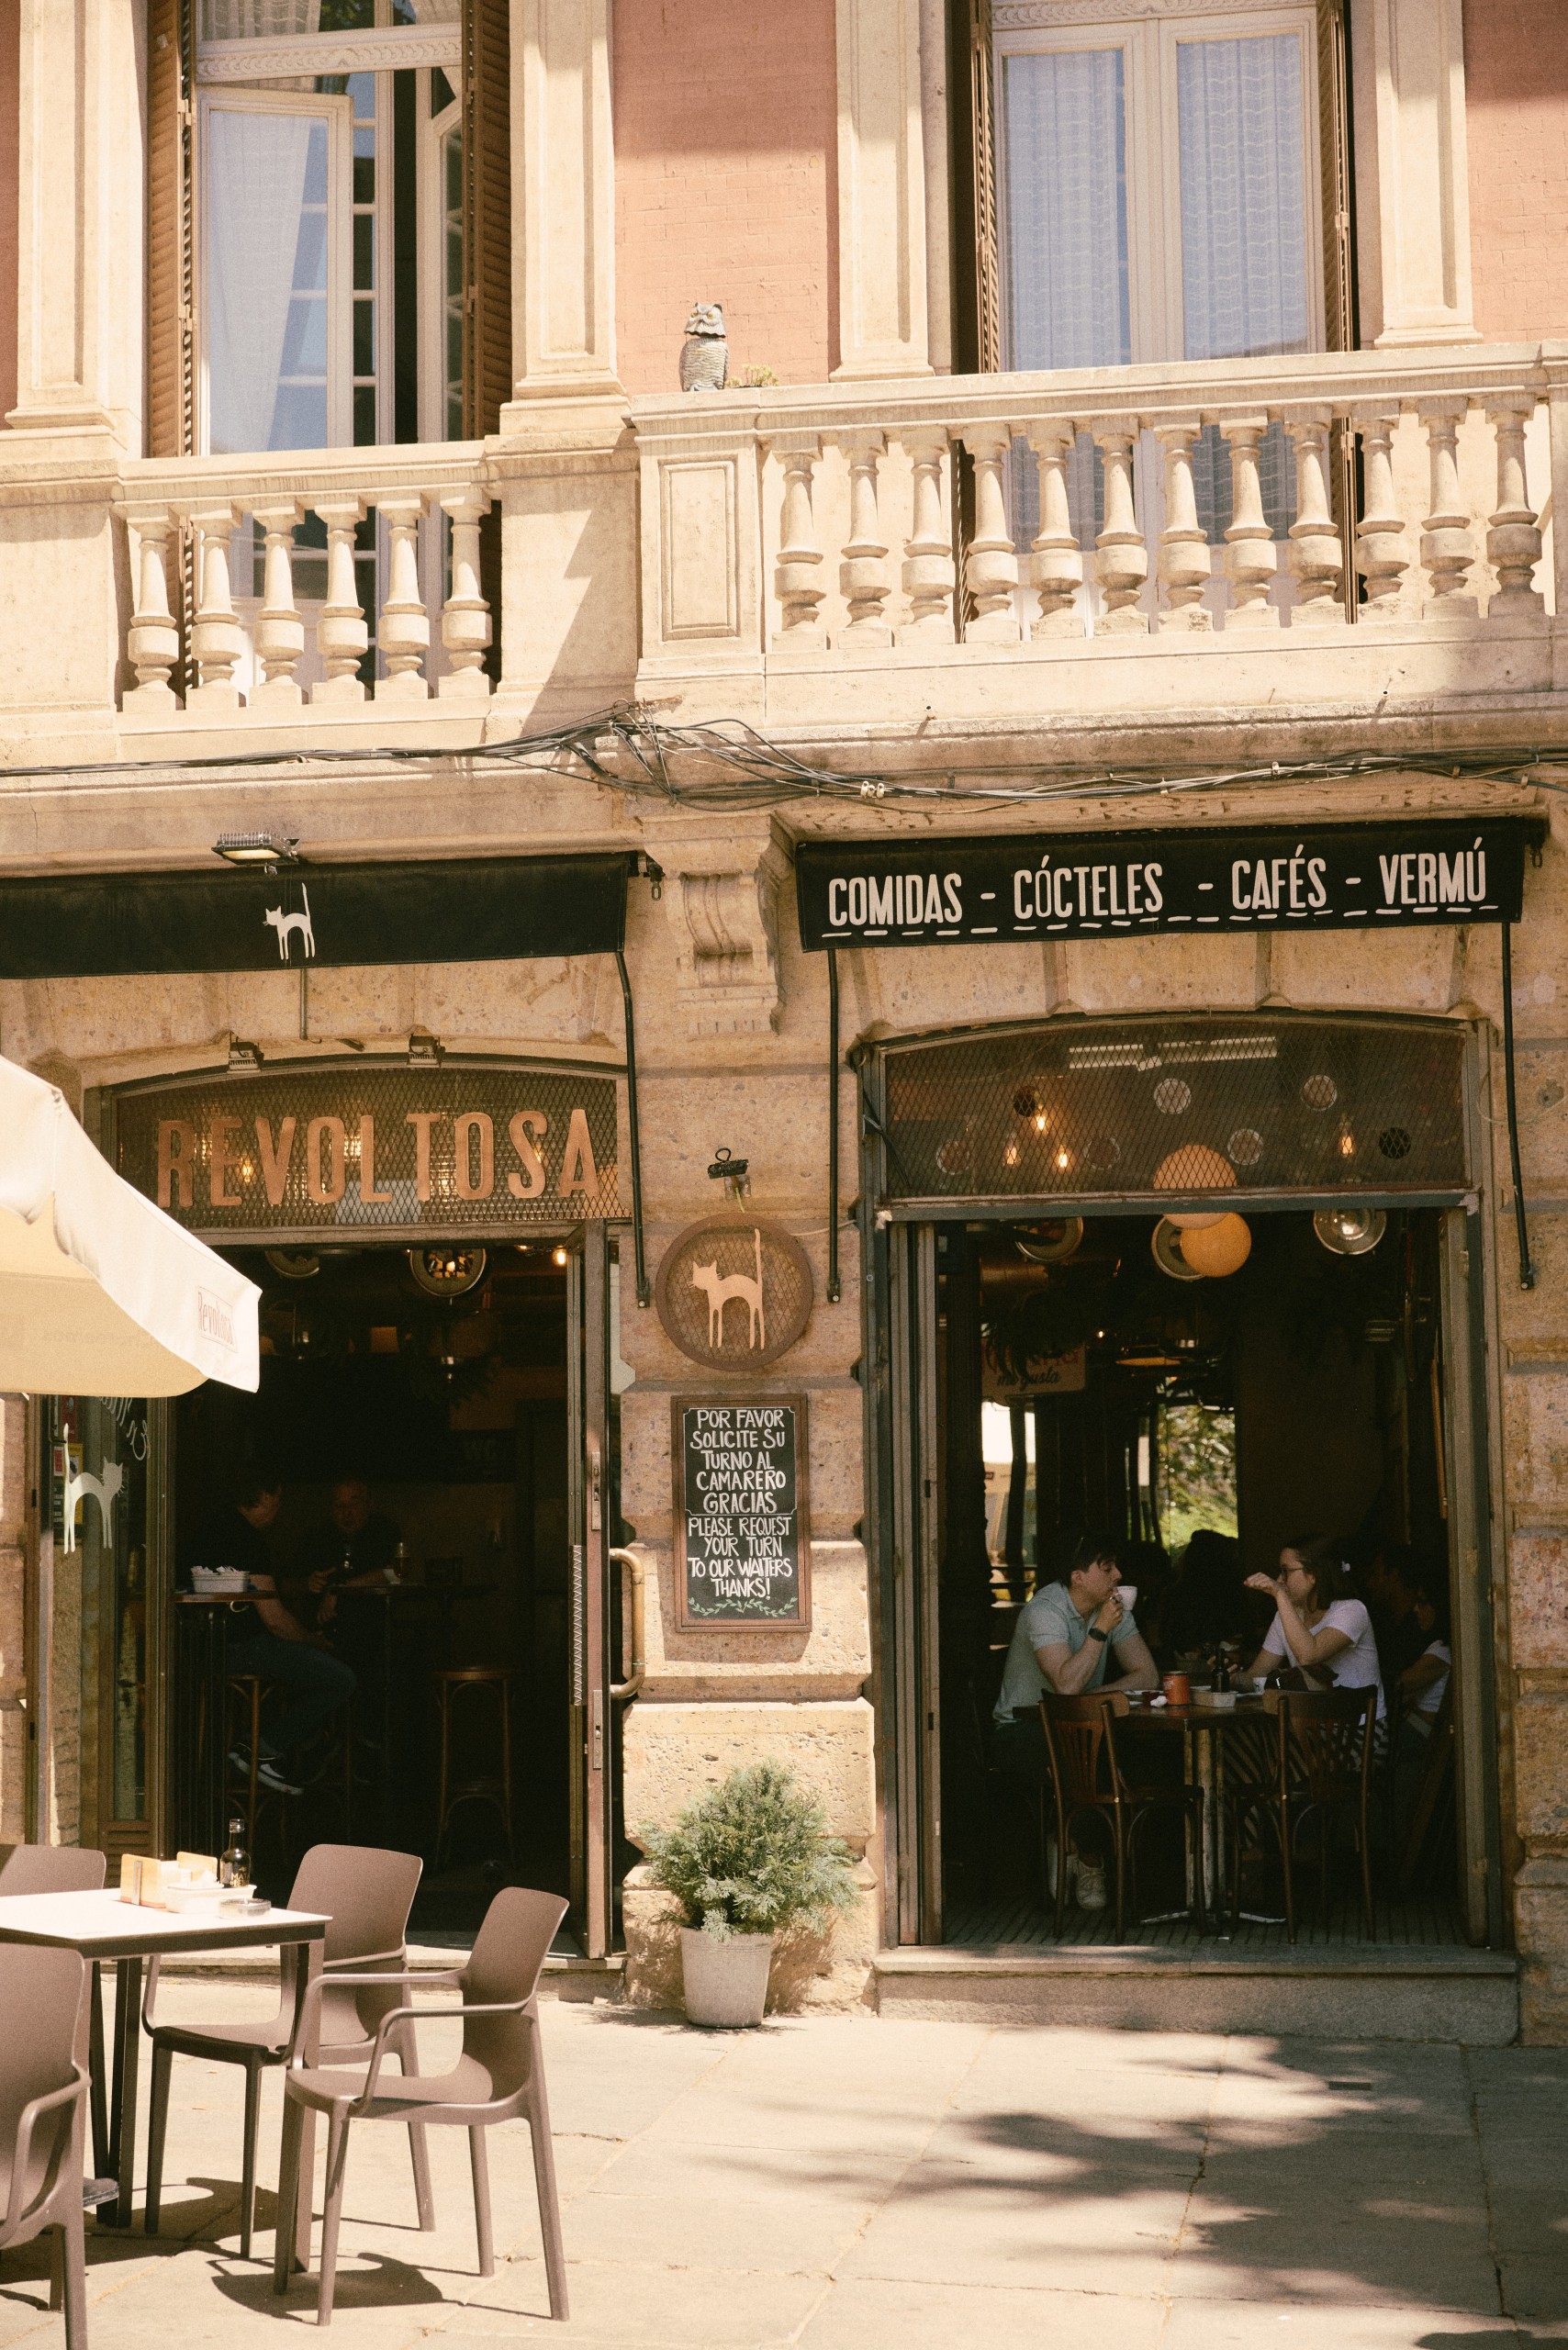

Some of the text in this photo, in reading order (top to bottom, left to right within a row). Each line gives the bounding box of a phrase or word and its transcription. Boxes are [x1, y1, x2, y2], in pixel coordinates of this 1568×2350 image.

[829, 874, 963, 926] COMIDAS
[1014, 855, 1163, 920] CÓCTELES
[1232, 844, 1327, 910] CAFÉS
[1379, 837, 1486, 906] VERMÚ
[157, 1109, 599, 1207] REVOLTOSA
[697, 1409, 785, 1429] POR FAVOR
[690, 1428, 786, 1449] SOLICITE SU
[700, 1449, 775, 1471] TURNO AL
[696, 1470, 787, 1492] CAMARERO
[703, 1492, 778, 1515] GRACIAS
[689, 1516, 792, 1538] PLEASE REQUEST
[704, 1536, 783, 1558] YOUR TURN
[688, 1557, 793, 1578] TO OUR WAITERS
[711, 1577, 771, 1601] THANKS!
